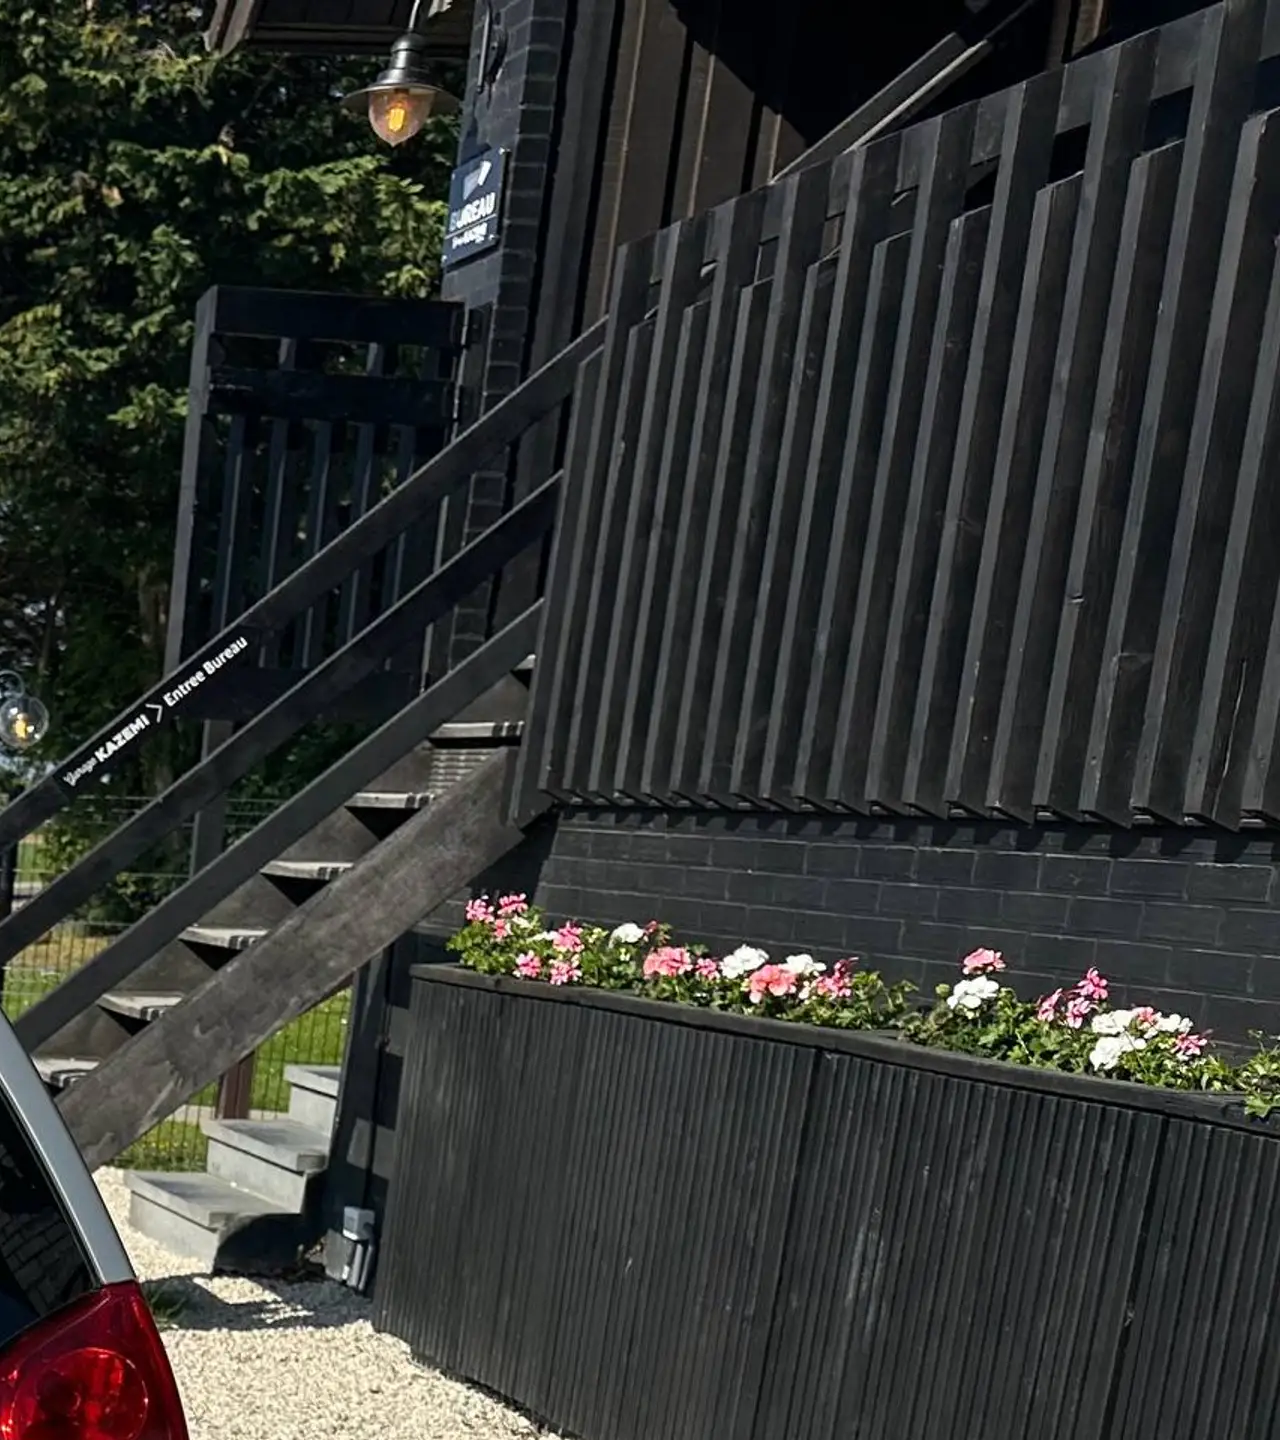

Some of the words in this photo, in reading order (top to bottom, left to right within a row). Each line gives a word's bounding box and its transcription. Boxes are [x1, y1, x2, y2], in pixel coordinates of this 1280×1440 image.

[449, 192, 496, 232] BUREAU
[95, 714, 151, 762] KAZEMI
[163, 670, 206, 707] Entree
[203, 637, 248, 675] Bureau
